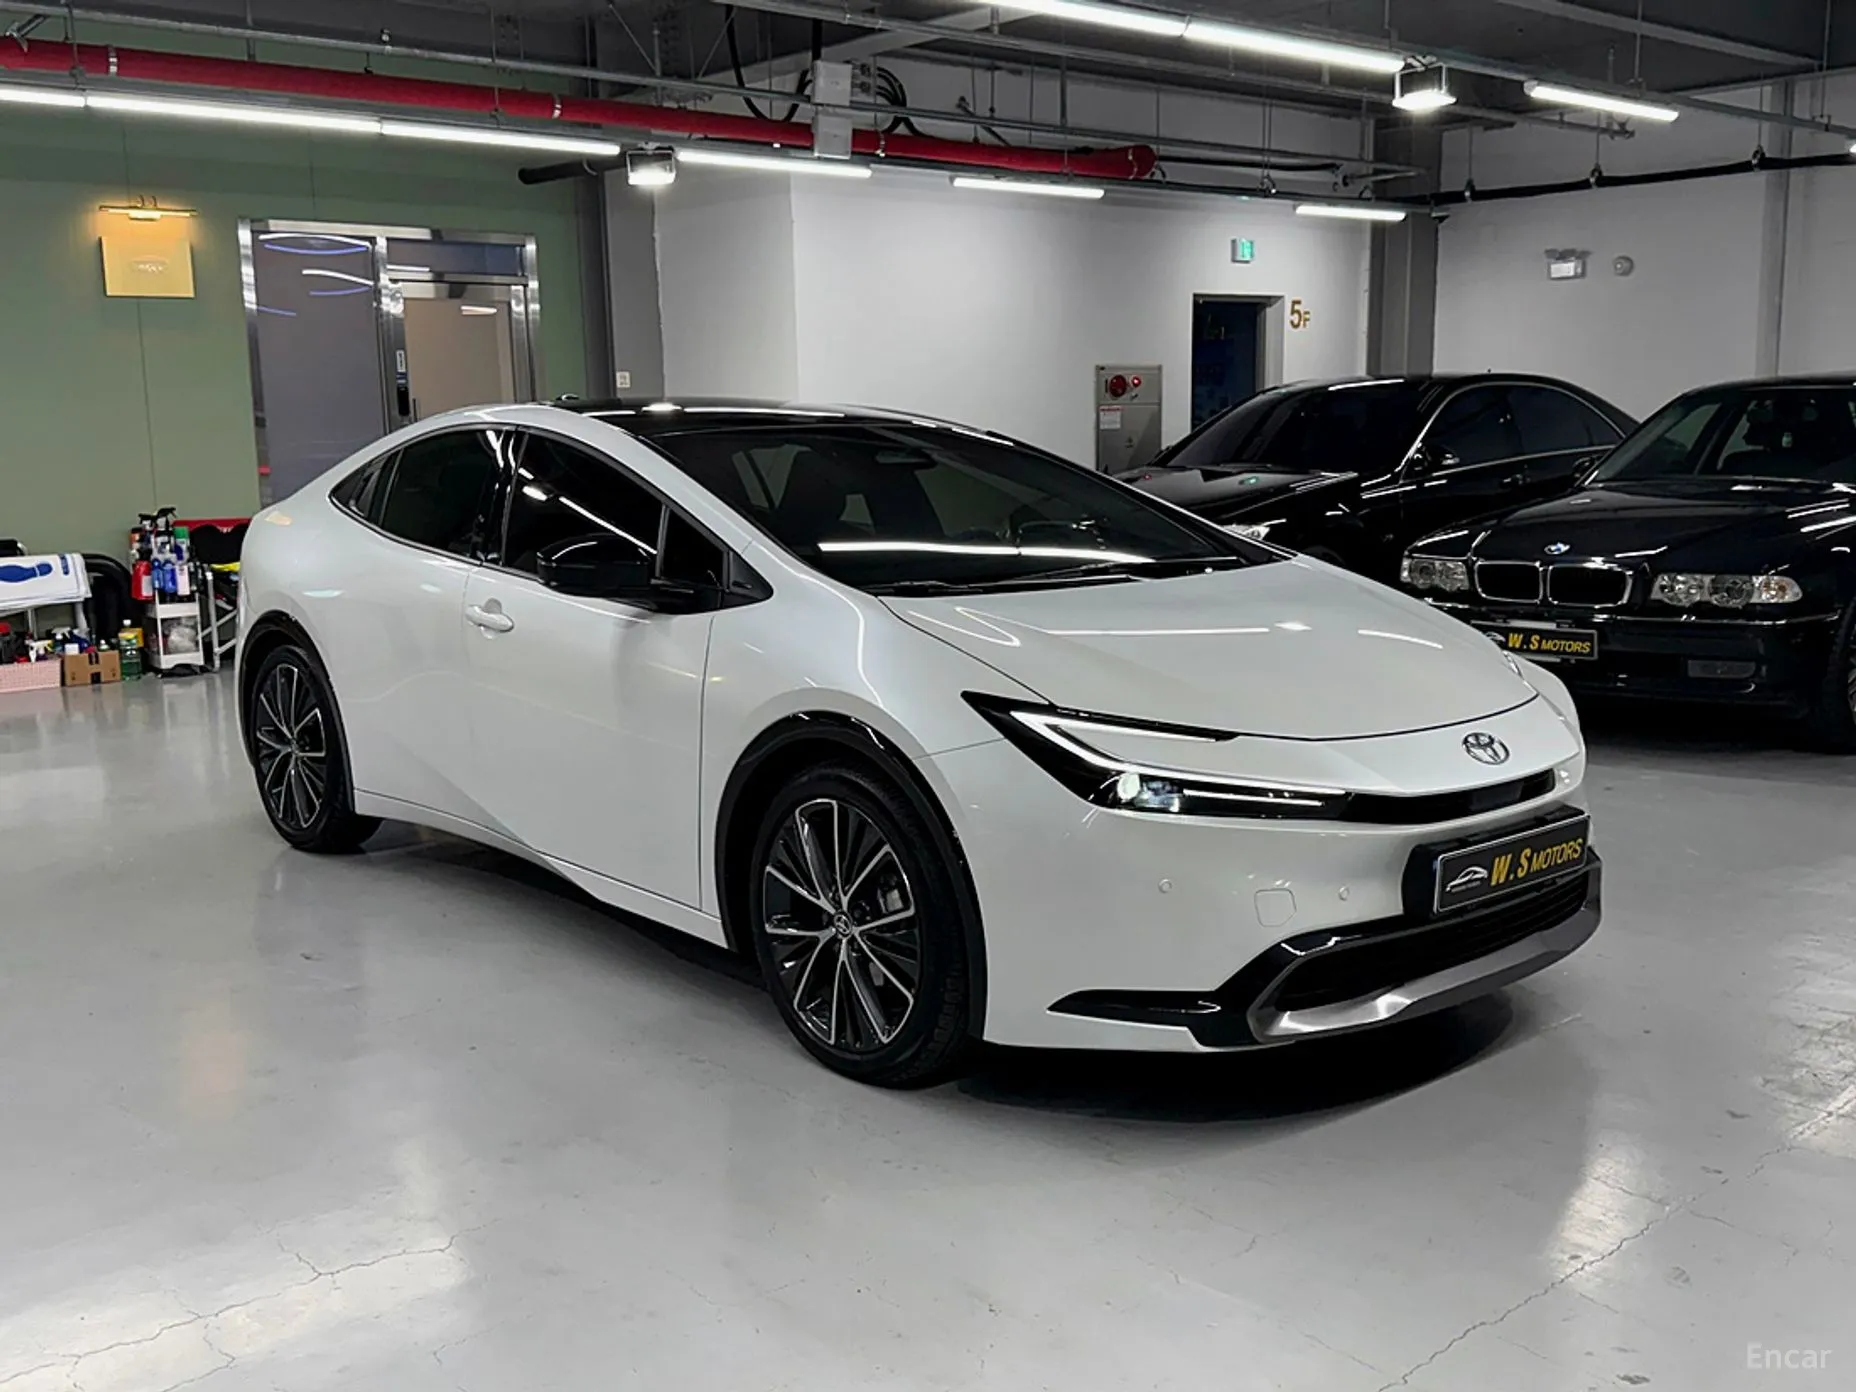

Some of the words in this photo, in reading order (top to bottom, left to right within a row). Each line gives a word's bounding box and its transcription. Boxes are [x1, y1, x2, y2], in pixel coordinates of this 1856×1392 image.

[1289, 299, 1311, 330] 5F
[1541, 639, 1591, 654] MOTORS
[1530, 838, 1584, 873] MOTORS
